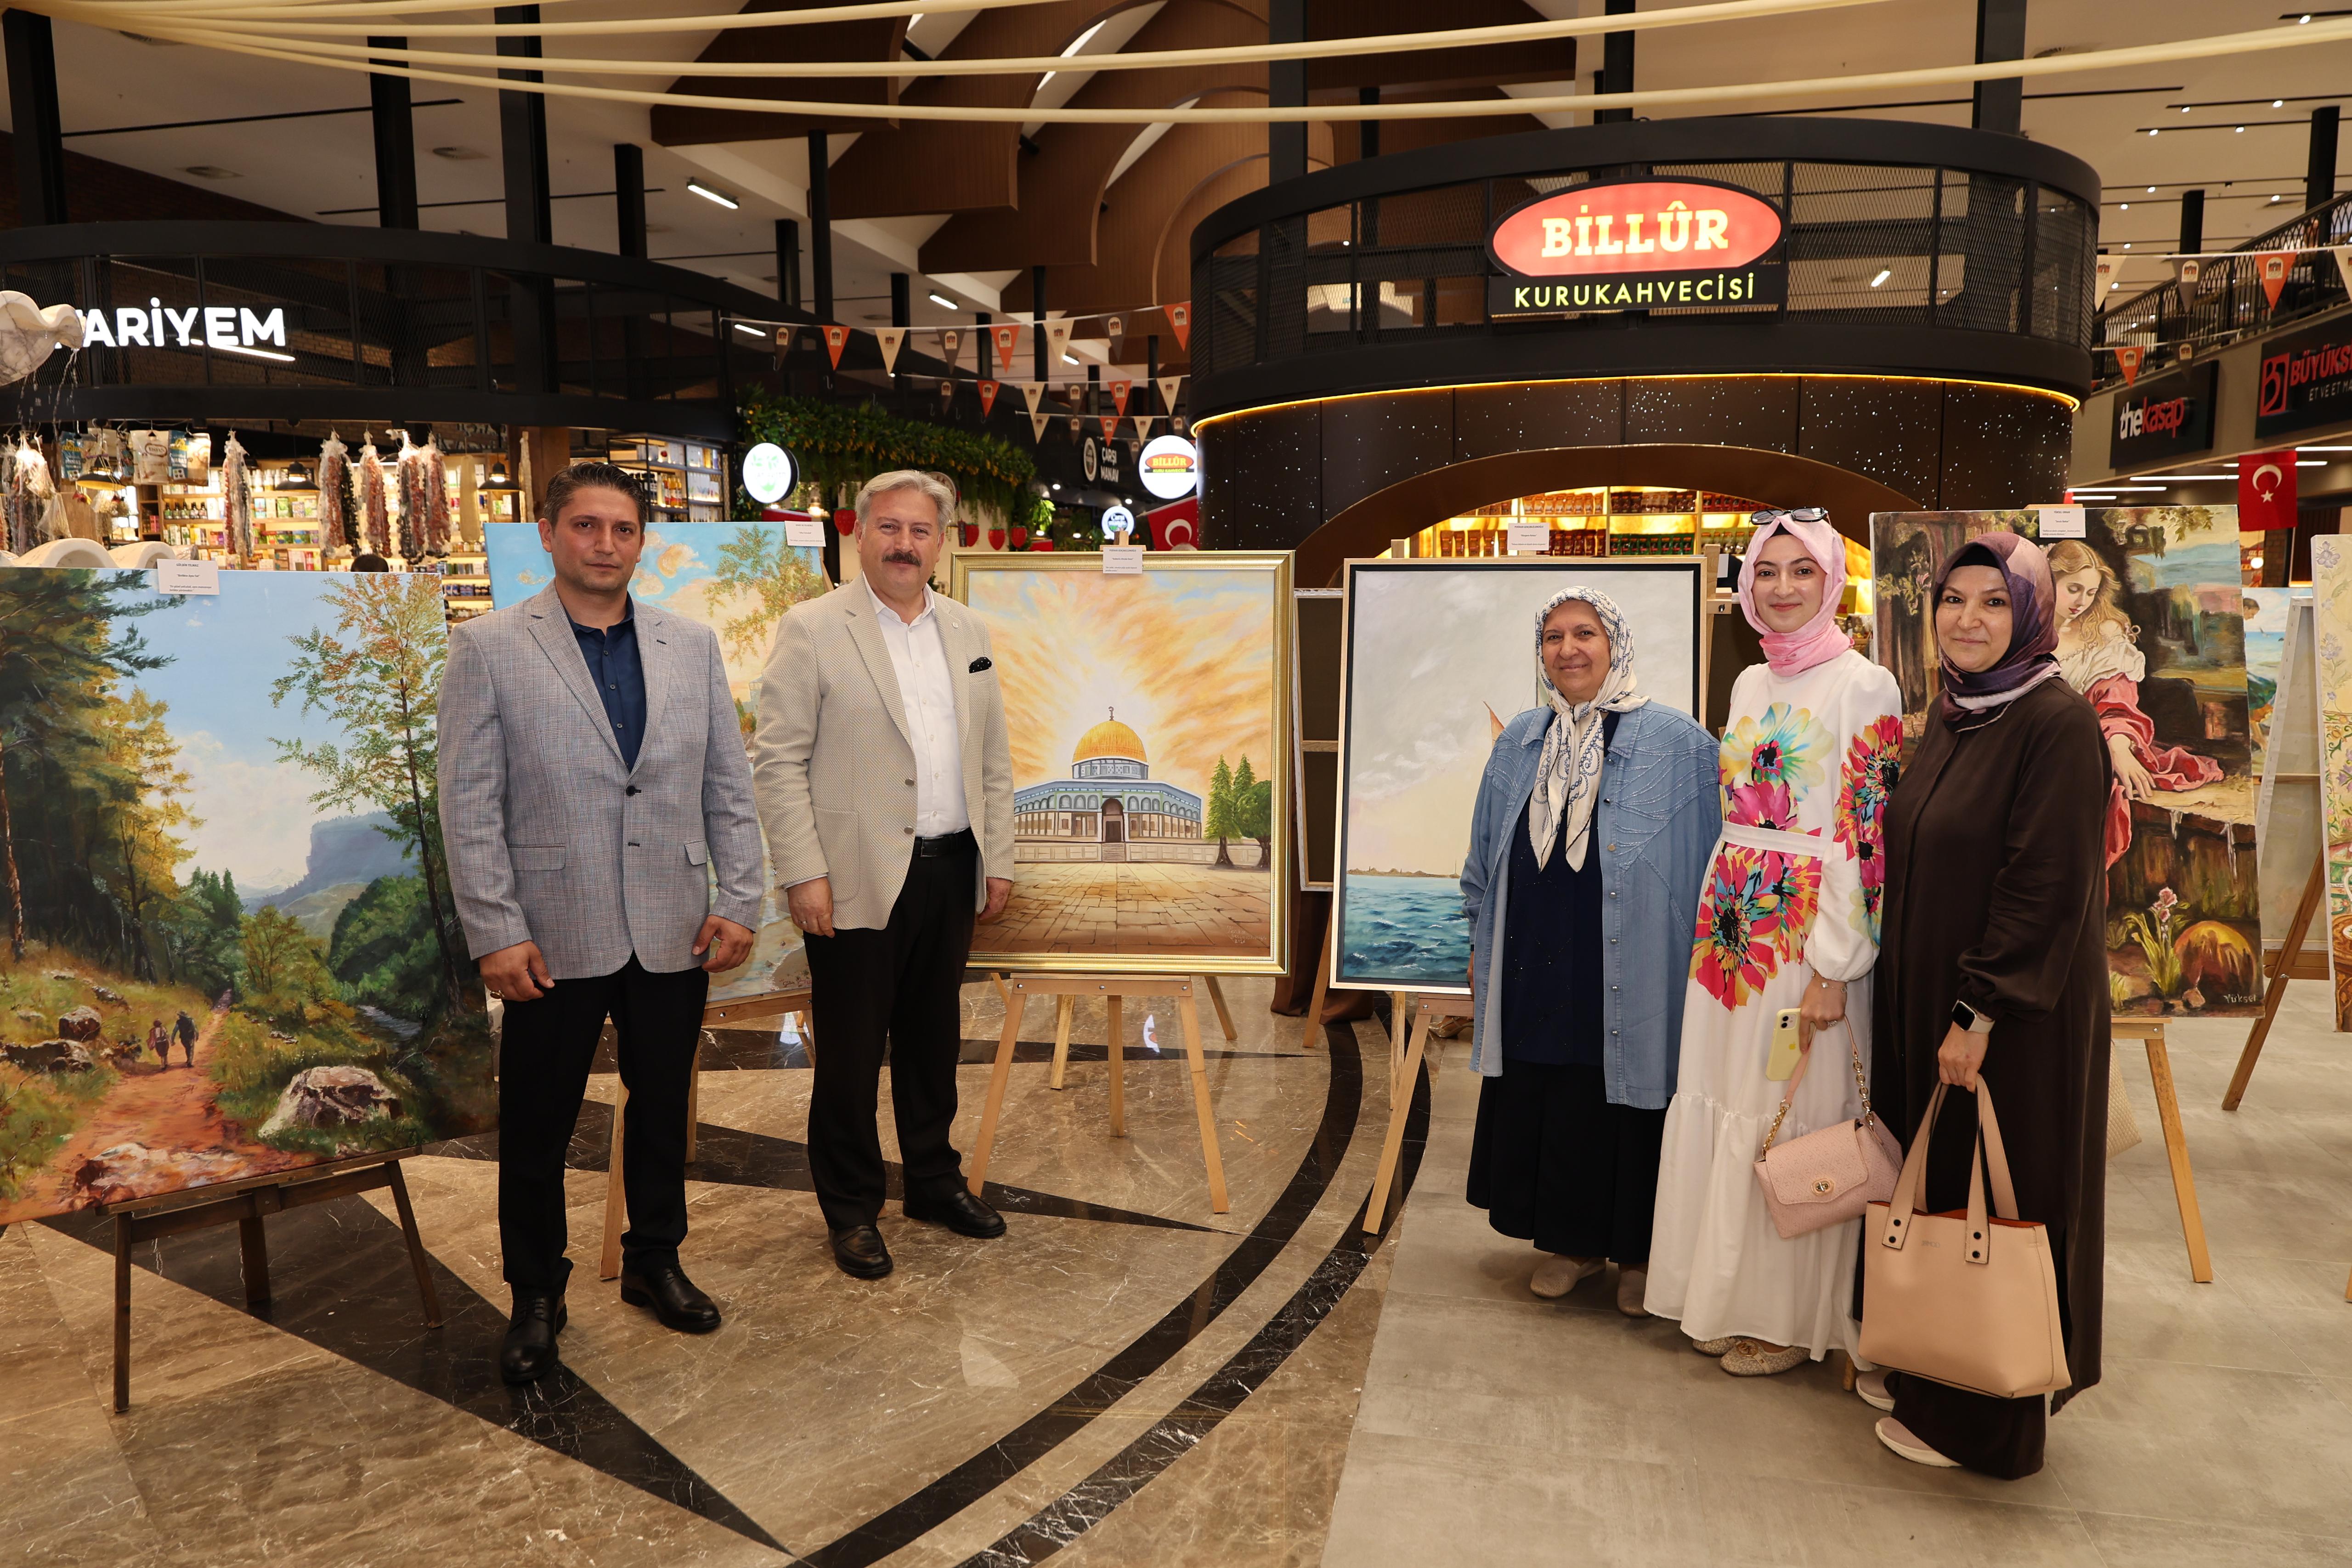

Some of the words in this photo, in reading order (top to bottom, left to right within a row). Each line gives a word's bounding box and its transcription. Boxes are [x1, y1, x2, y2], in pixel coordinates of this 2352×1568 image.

[1542, 200, 1729, 258] BİLLÛR
[1515, 272, 1755, 308] KURUKAHVECİSİ
[2290, 338, 2352, 386] BÜYÜKS
[2309, 387, 2319, 402] ET
[2321, 384, 2330, 398] VE
[1101, 466, 1119, 483] MANAV
[2223, 994, 2256, 1004] Yüksel
